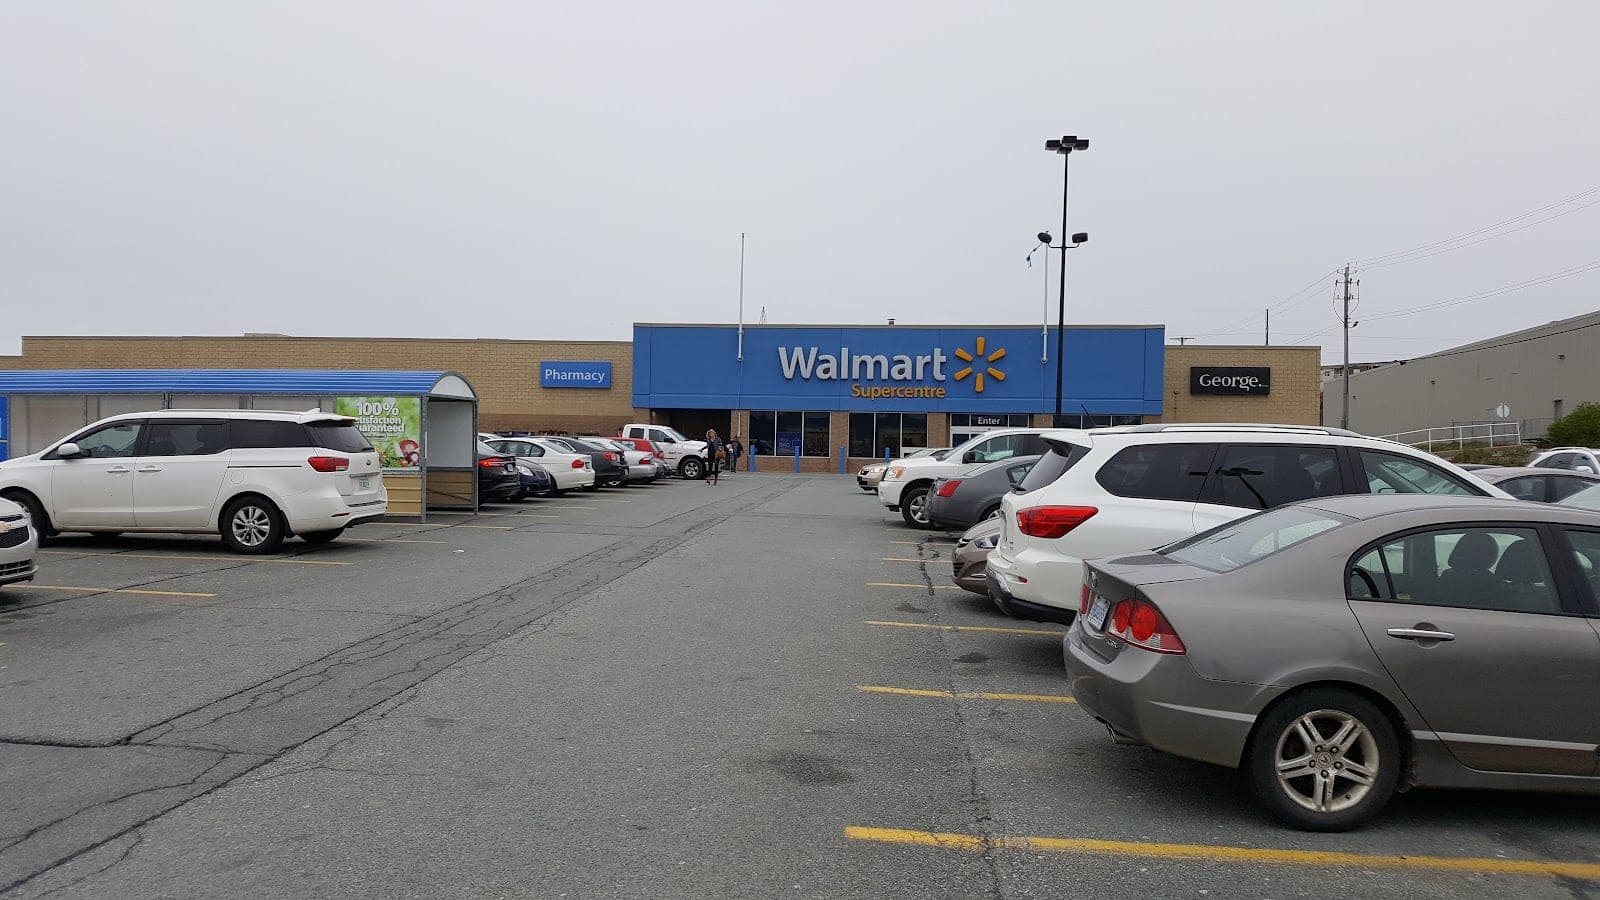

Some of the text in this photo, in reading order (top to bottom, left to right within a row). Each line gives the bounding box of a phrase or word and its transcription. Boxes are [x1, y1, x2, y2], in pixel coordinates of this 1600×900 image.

[778, 346, 947, 381] Walmart
[545, 368, 605, 384] Pharmacy
[851, 383, 946, 400] Supercentre
[356, 402, 400, 416] 100%
[356, 423, 406, 433] uaranteed
[977, 416, 1001, 425] Enter
